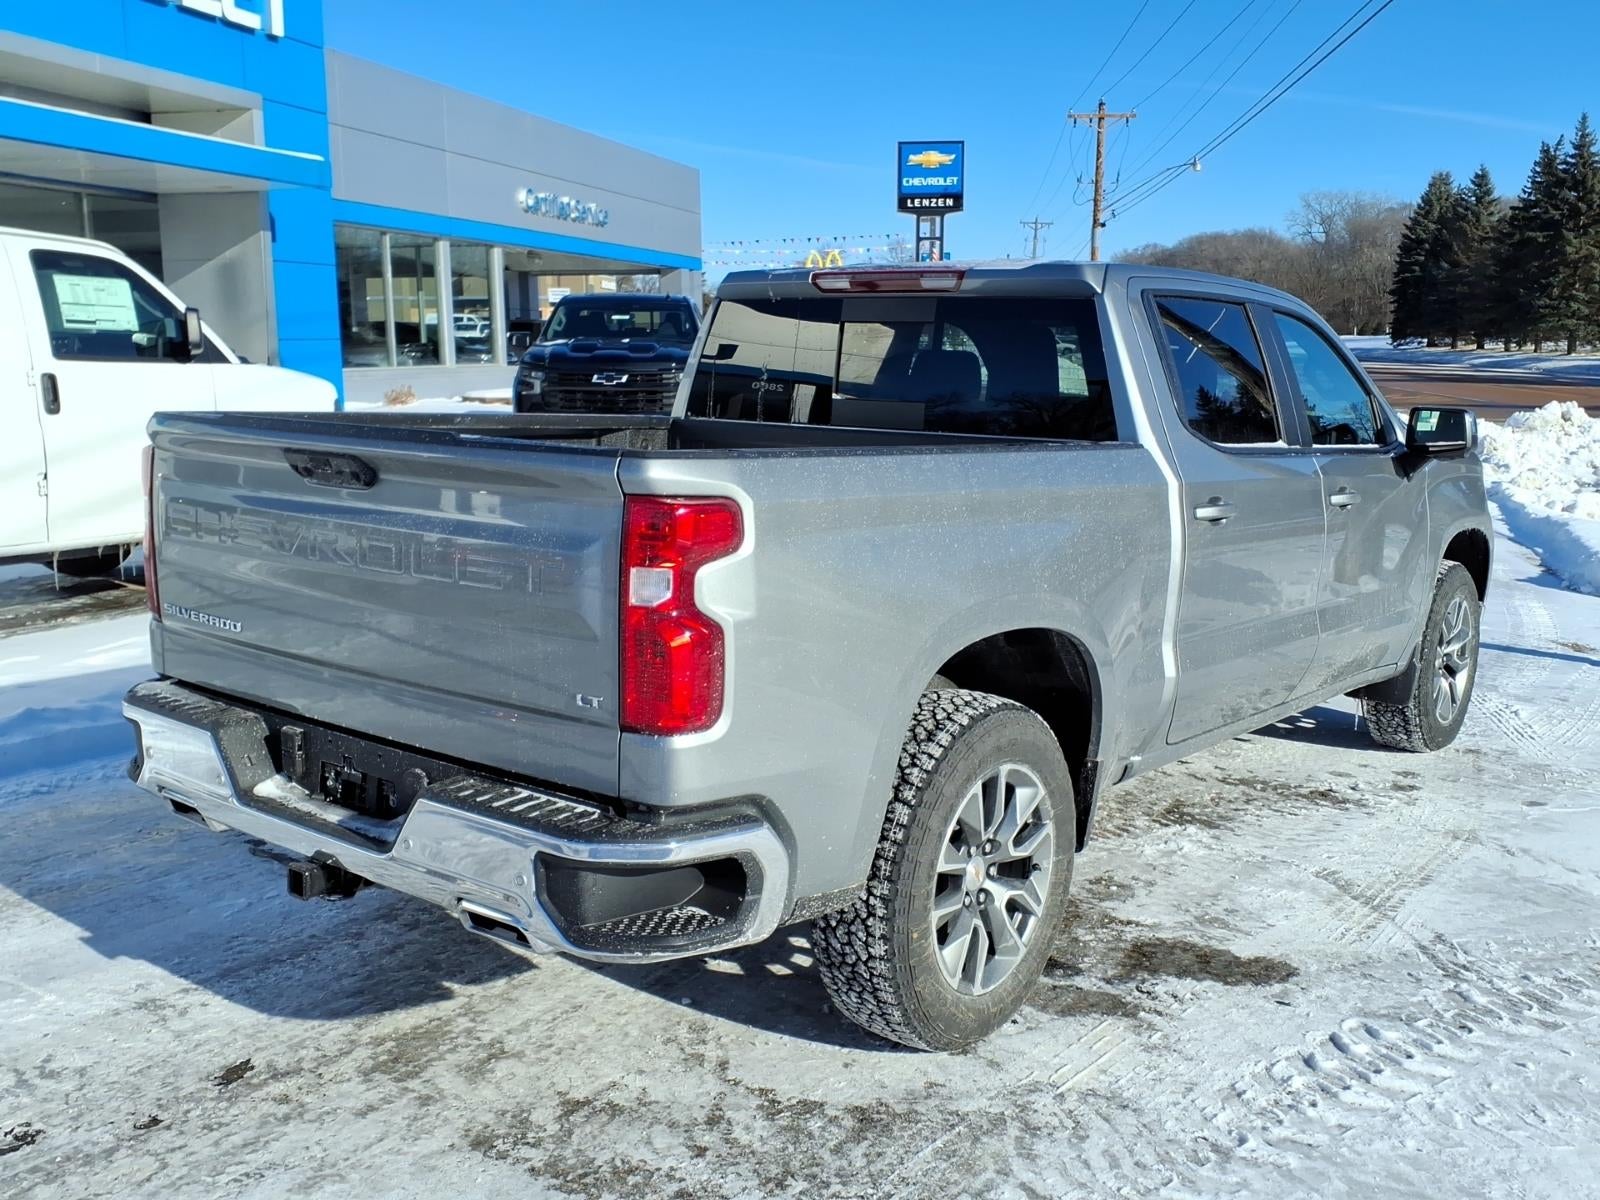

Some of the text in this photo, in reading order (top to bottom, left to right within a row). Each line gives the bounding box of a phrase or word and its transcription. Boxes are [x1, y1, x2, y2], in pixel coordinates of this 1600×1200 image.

[903, 177, 958, 186] CHEVROLET
[517, 188, 609, 227] Certified Service
[907, 198, 954, 207] LENZEN
[165, 500, 566, 595] CHEVROLET
[163, 603, 242, 633] SILVERADO
[576, 693, 604, 709] LT
